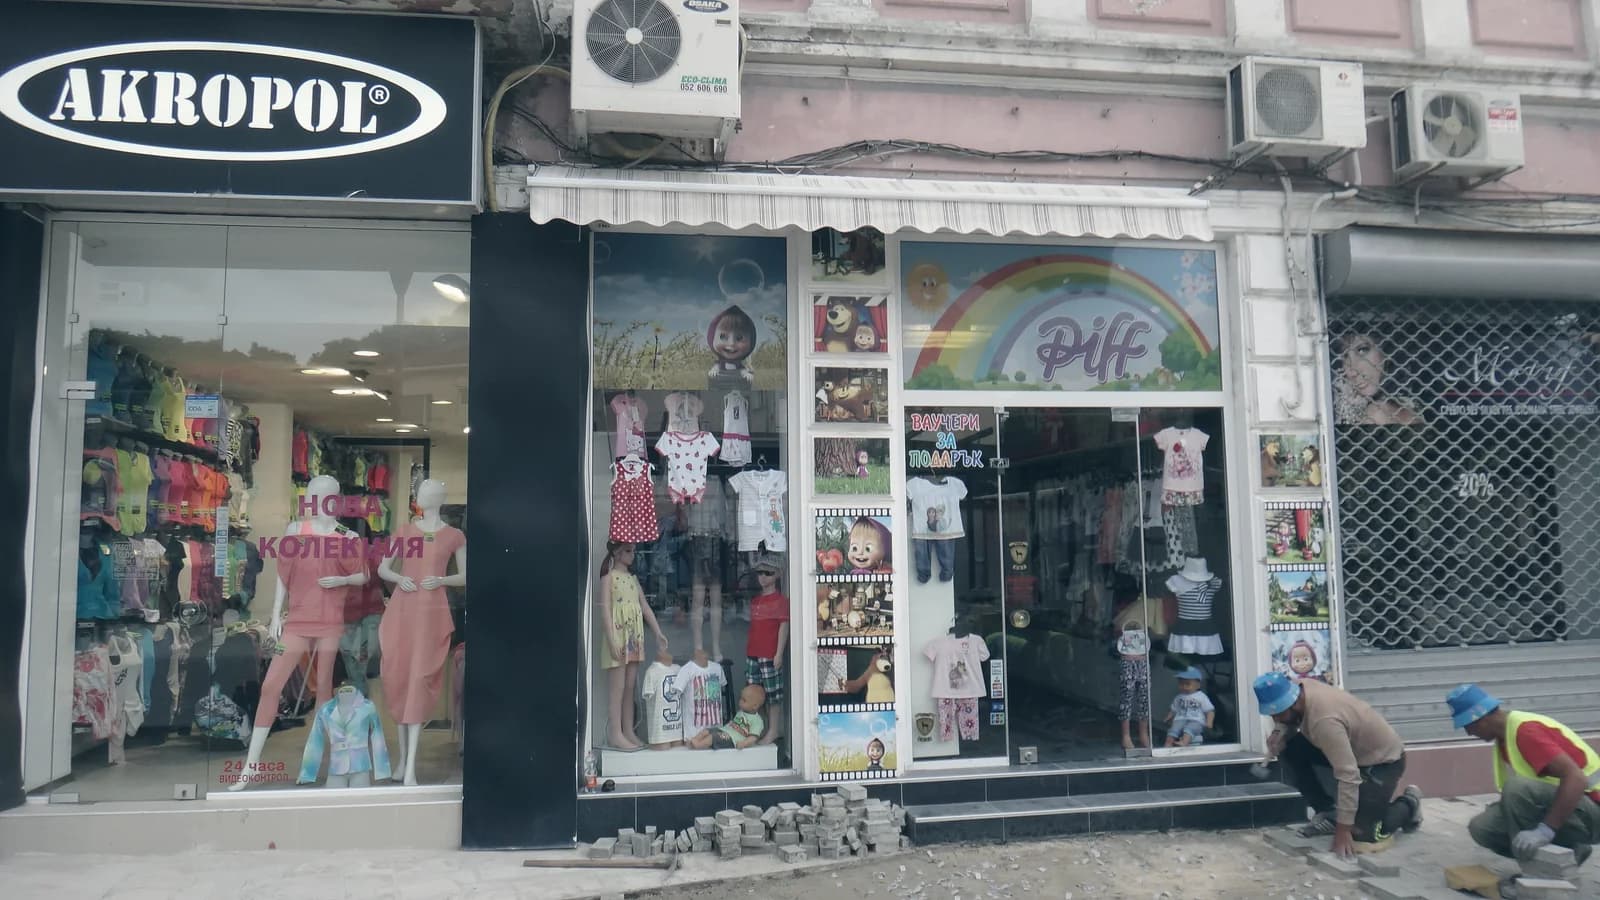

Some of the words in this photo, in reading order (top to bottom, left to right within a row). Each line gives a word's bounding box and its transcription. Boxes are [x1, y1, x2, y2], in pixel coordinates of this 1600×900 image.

[680, 83, 694, 92] 052
[697, 84, 711, 93] 606
[713, 85, 728, 94] 690
[681, 75, 727, 84] ECO-CLIMA
[910, 413, 980, 431] ВАУЧЕРИ
[936, 432, 957, 450] ЗА
[909, 450, 984, 469] ПОДАРЪК
[298, 494, 383, 518] НОВА
[258, 535, 425, 560] КОЛЕКЦИЯ
[223, 760, 243, 772] 24
[249, 761, 285, 771] часа
